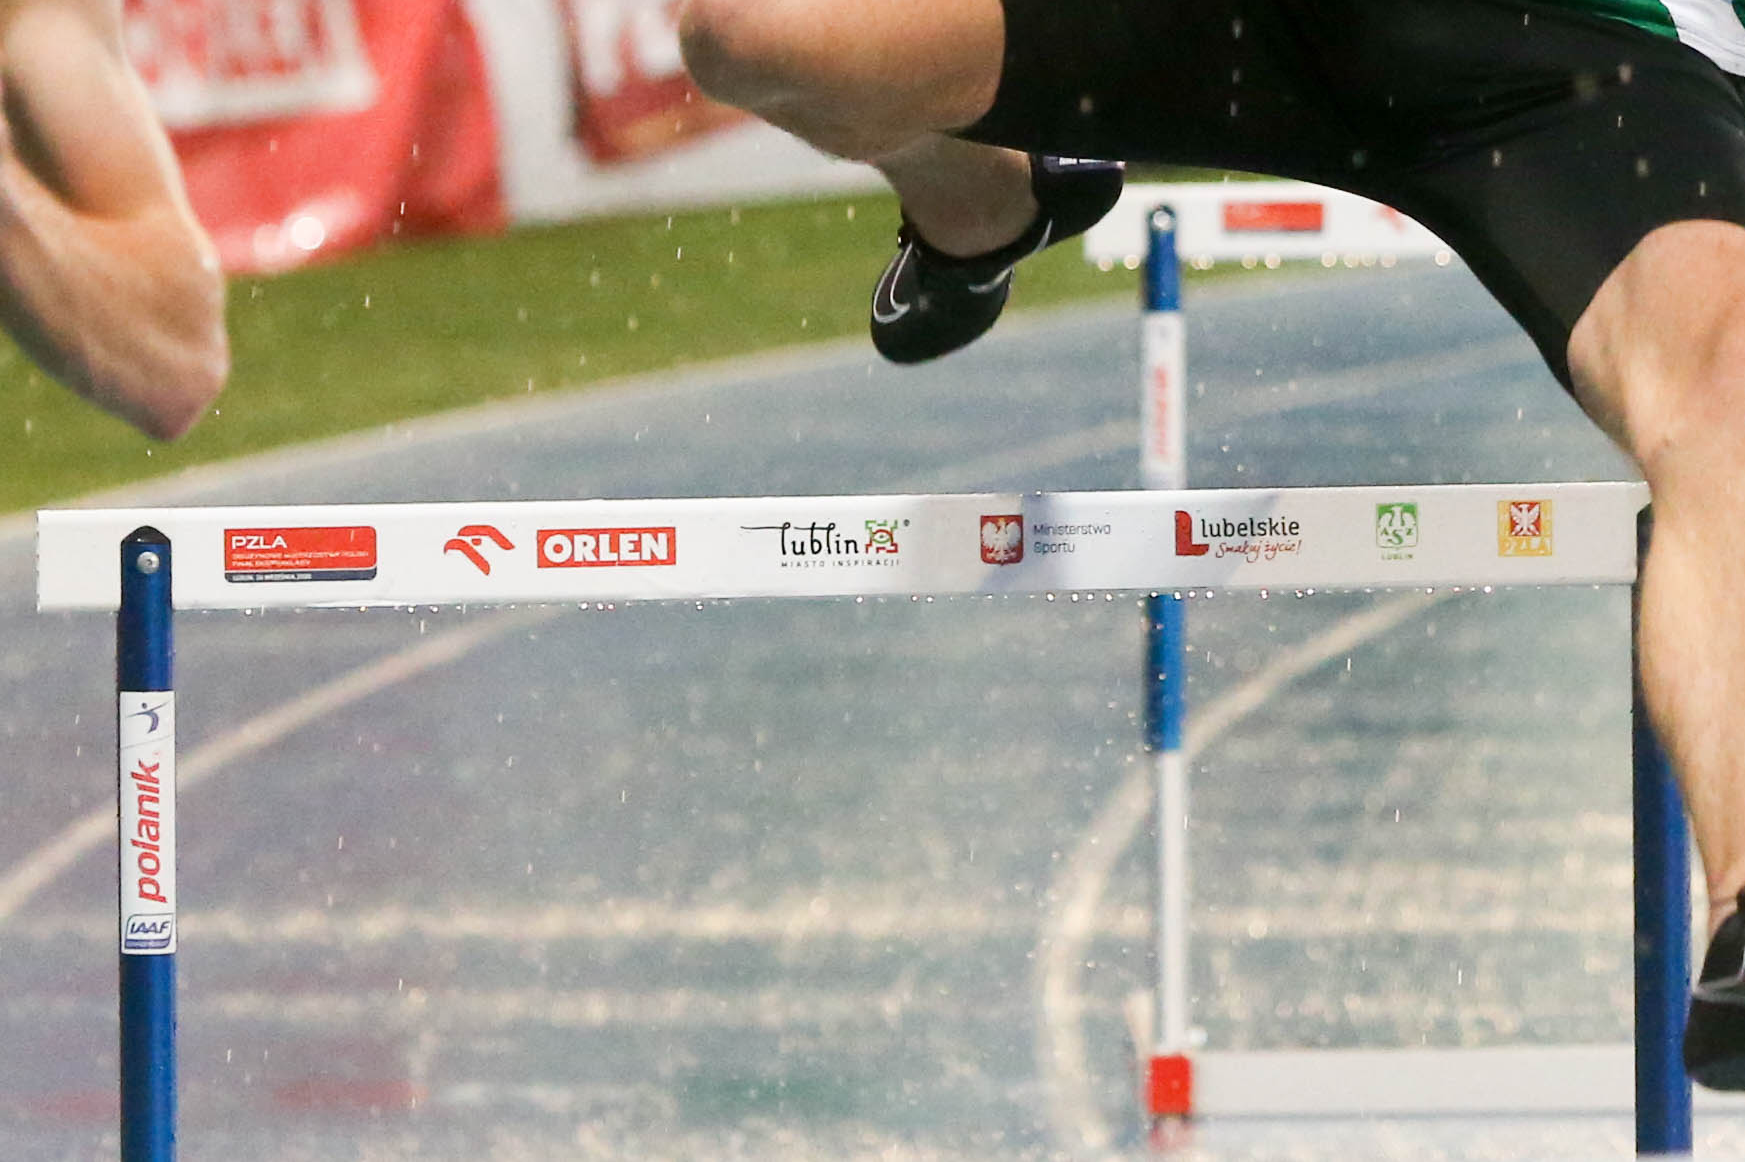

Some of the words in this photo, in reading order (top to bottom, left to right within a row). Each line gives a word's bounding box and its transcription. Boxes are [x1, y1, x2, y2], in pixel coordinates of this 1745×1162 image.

[231, 535, 288, 549] PZLA
[543, 533, 669, 563] ORLEN
[1033, 541, 1075, 555] Sportu
[832, 559, 900, 567] INSPIRACJI
[130, 758, 168, 903] polanik
[130, 921, 171, 934] IAAF
